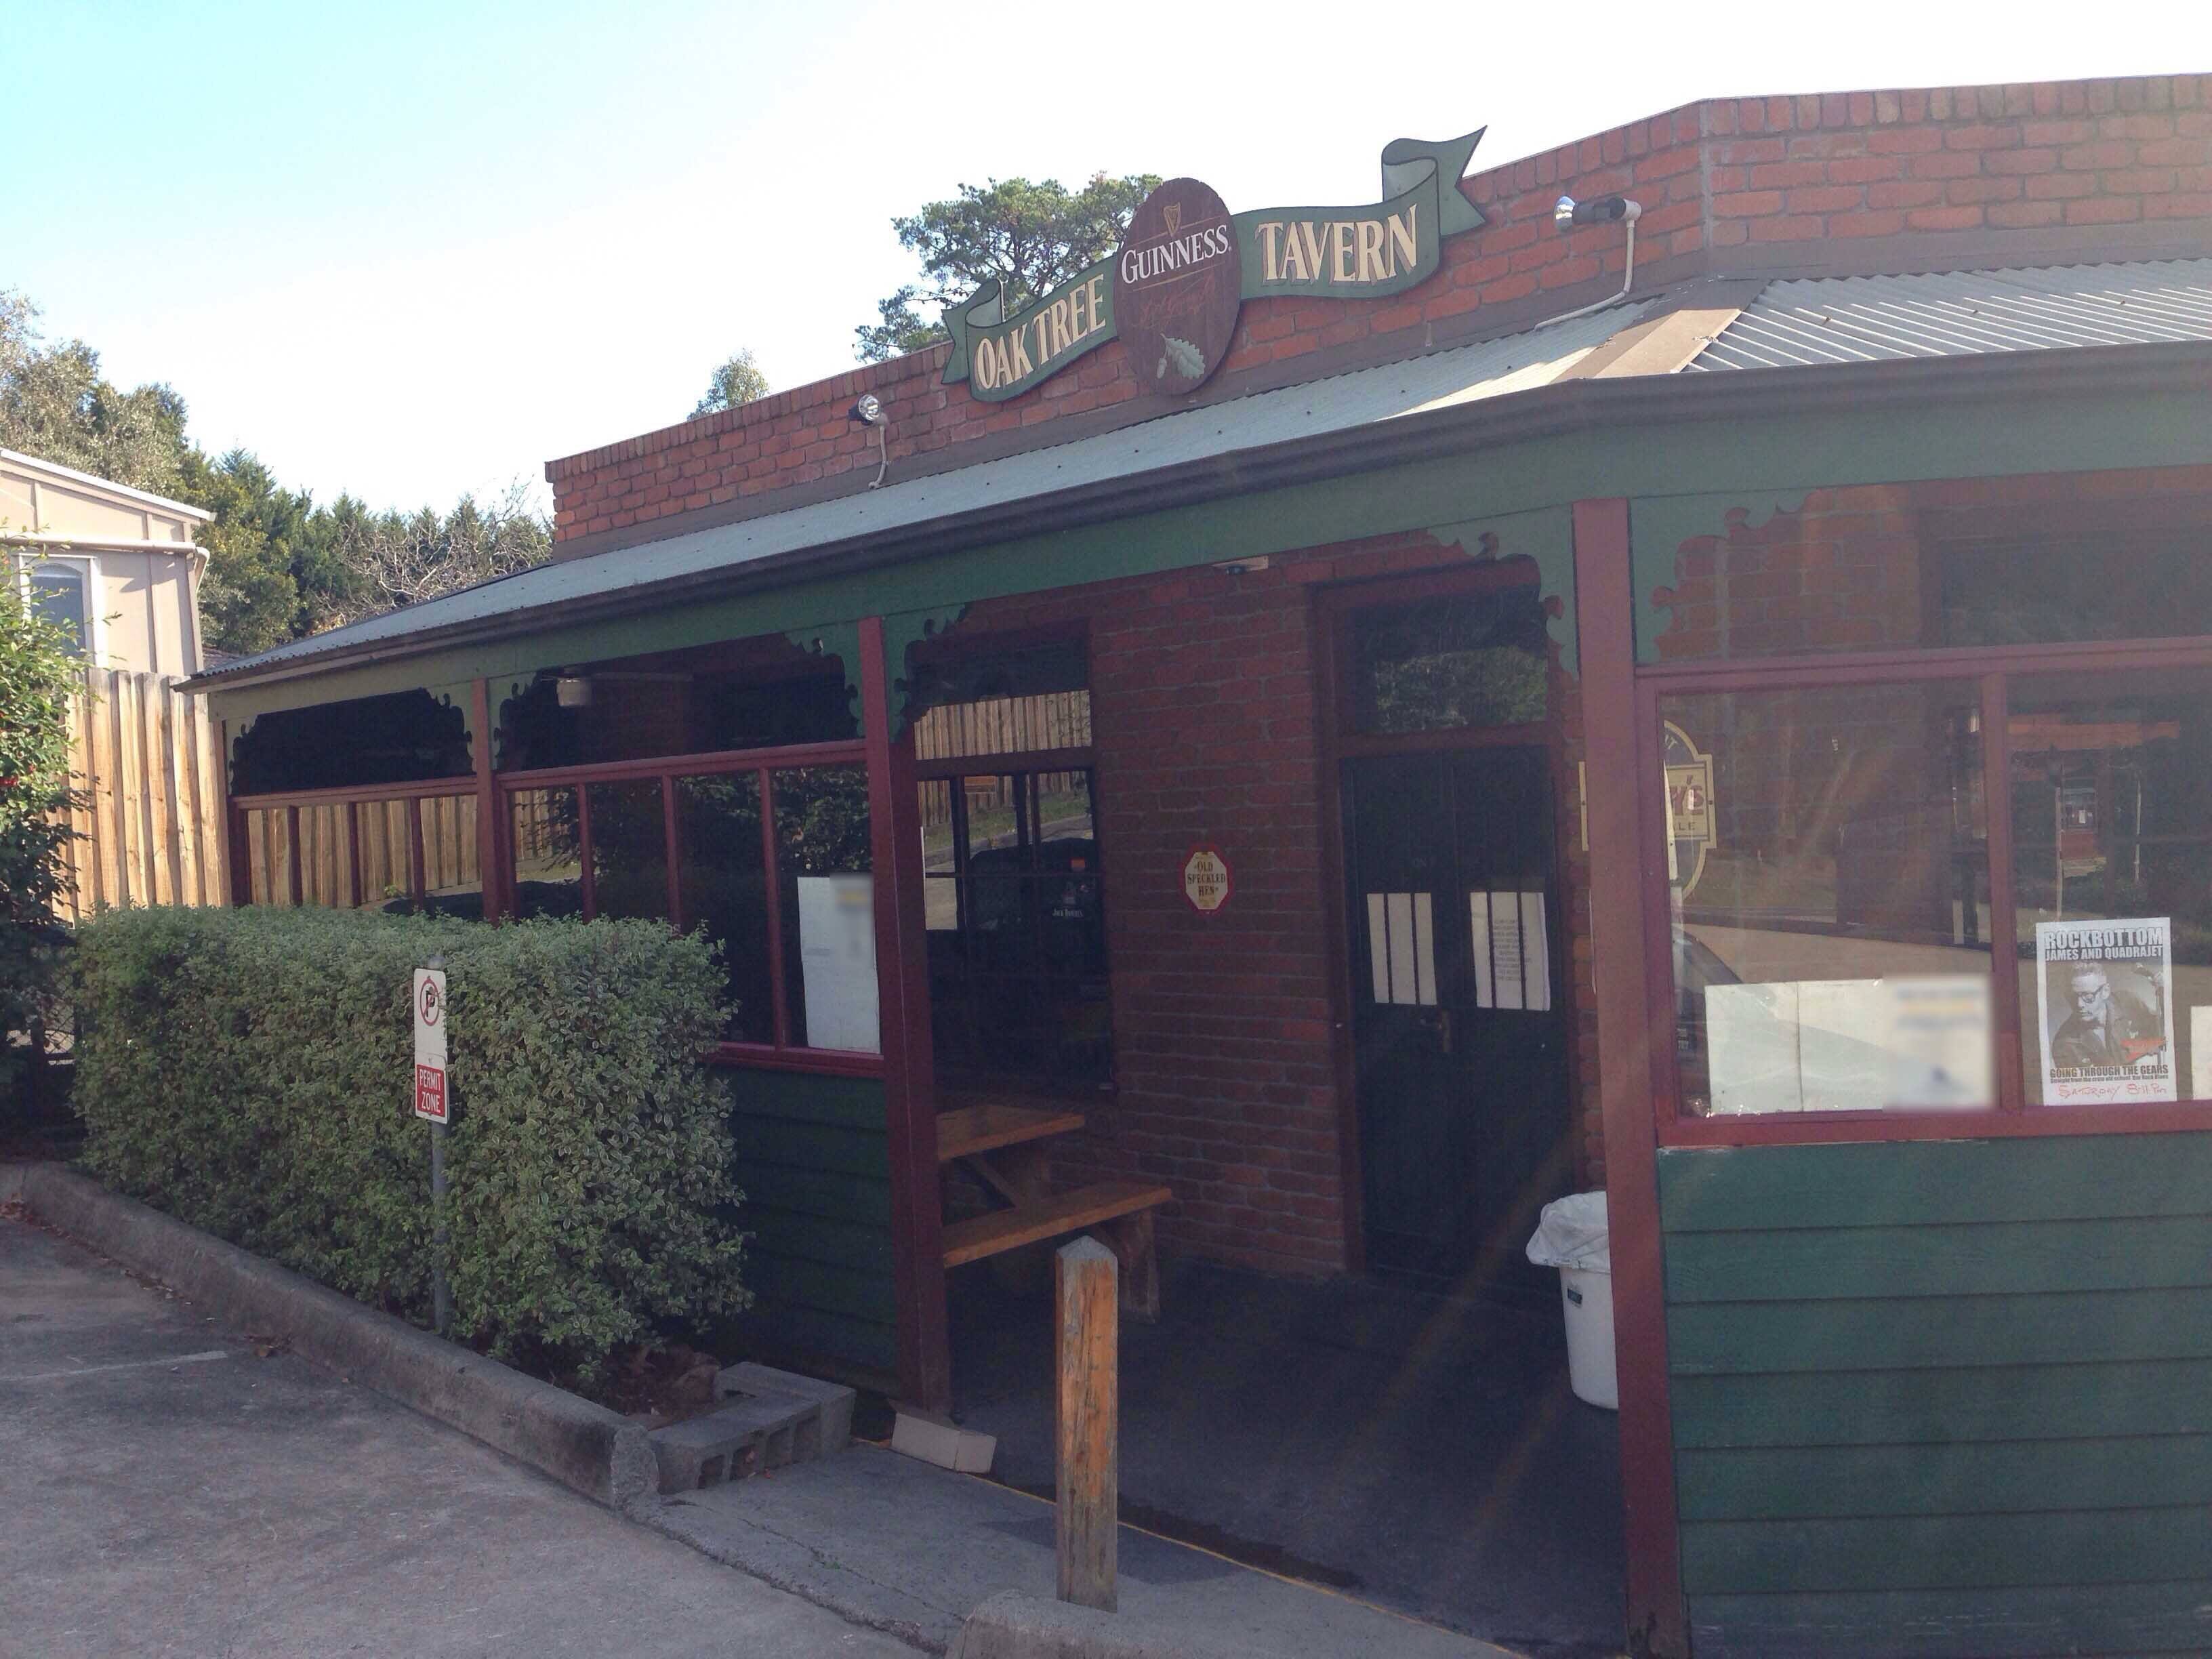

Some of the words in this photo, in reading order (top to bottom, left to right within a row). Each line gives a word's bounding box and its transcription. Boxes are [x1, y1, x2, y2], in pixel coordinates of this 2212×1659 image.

[1122, 224, 1229, 284] GUINNESS
[1256, 203, 1418, 283] TAVERN
[975, 322, 1034, 391] OAK
[1033, 273, 1106, 366] TREE
[1197, 861, 1214, 872] OLD
[1187, 873, 1226, 884] SPECKLED
[2043, 926, 2163, 949] ROCKBOTTOM
[2045, 948, 2080, 961] JAMES
[2081, 947, 2102, 960] AND
[2104, 945, 2163, 960] QUADRAJET
[419, 1068, 441, 1091] PERMIT
[2049, 1067, 2078, 1078] GOING
[2081, 1065, 2121, 1078] THROUGH
[2122, 1065, 2139, 1076] THE
[2139, 1064, 2169, 1075] GEARS
[422, 1090, 441, 1113] ZONE
